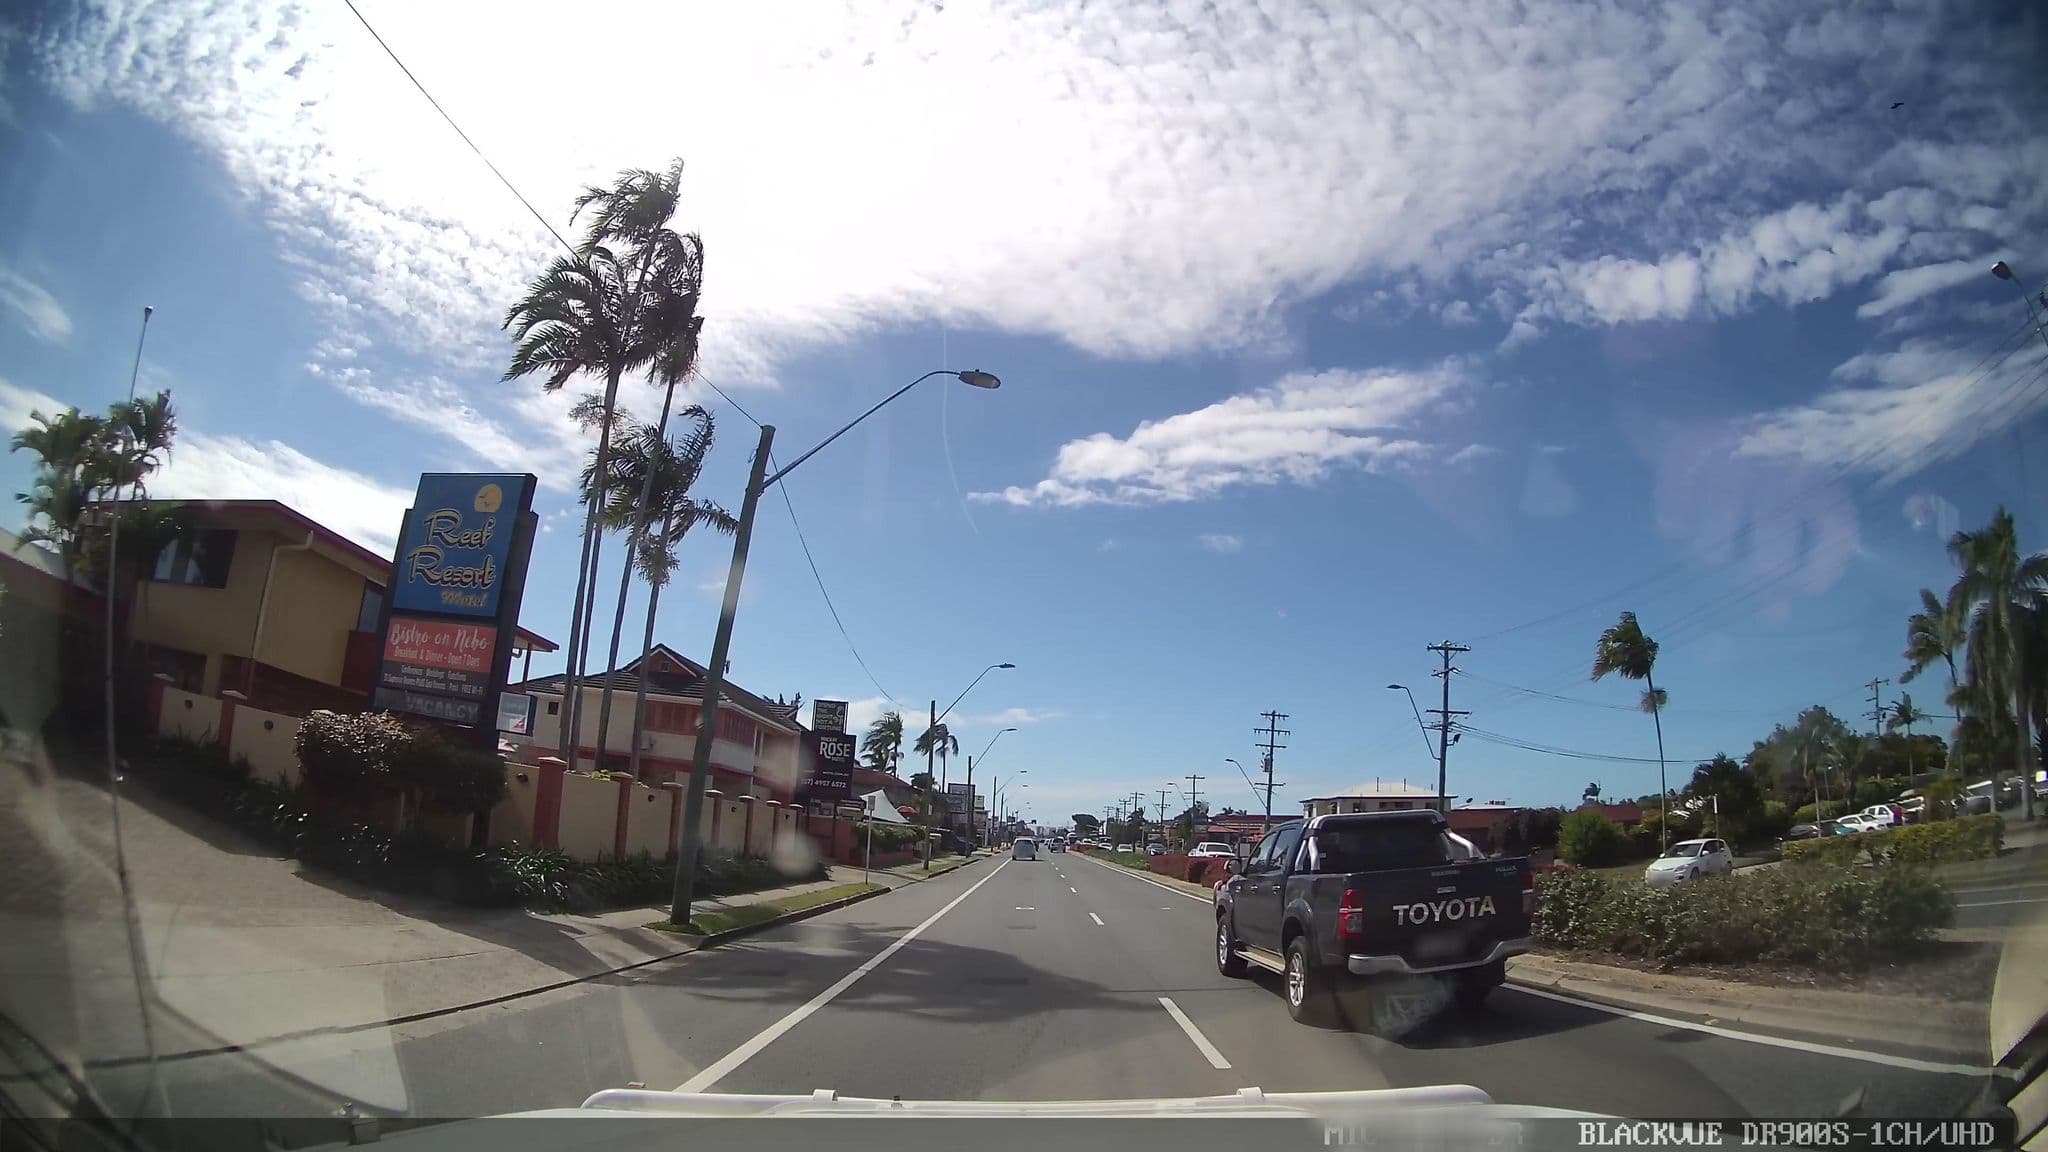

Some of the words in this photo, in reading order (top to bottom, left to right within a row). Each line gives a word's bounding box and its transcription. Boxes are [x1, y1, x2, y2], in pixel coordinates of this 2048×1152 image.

[424, 508, 496, 550] Reef
[407, 545, 497, 589] Resort
[390, 623, 429, 646] Bistro
[434, 632, 450, 645] on
[454, 627, 488, 653] Nebo
[406, 694, 479, 719] VACANCY
[820, 741, 851, 759] ROSE
[1393, 896, 1497, 926] TOYOTA
